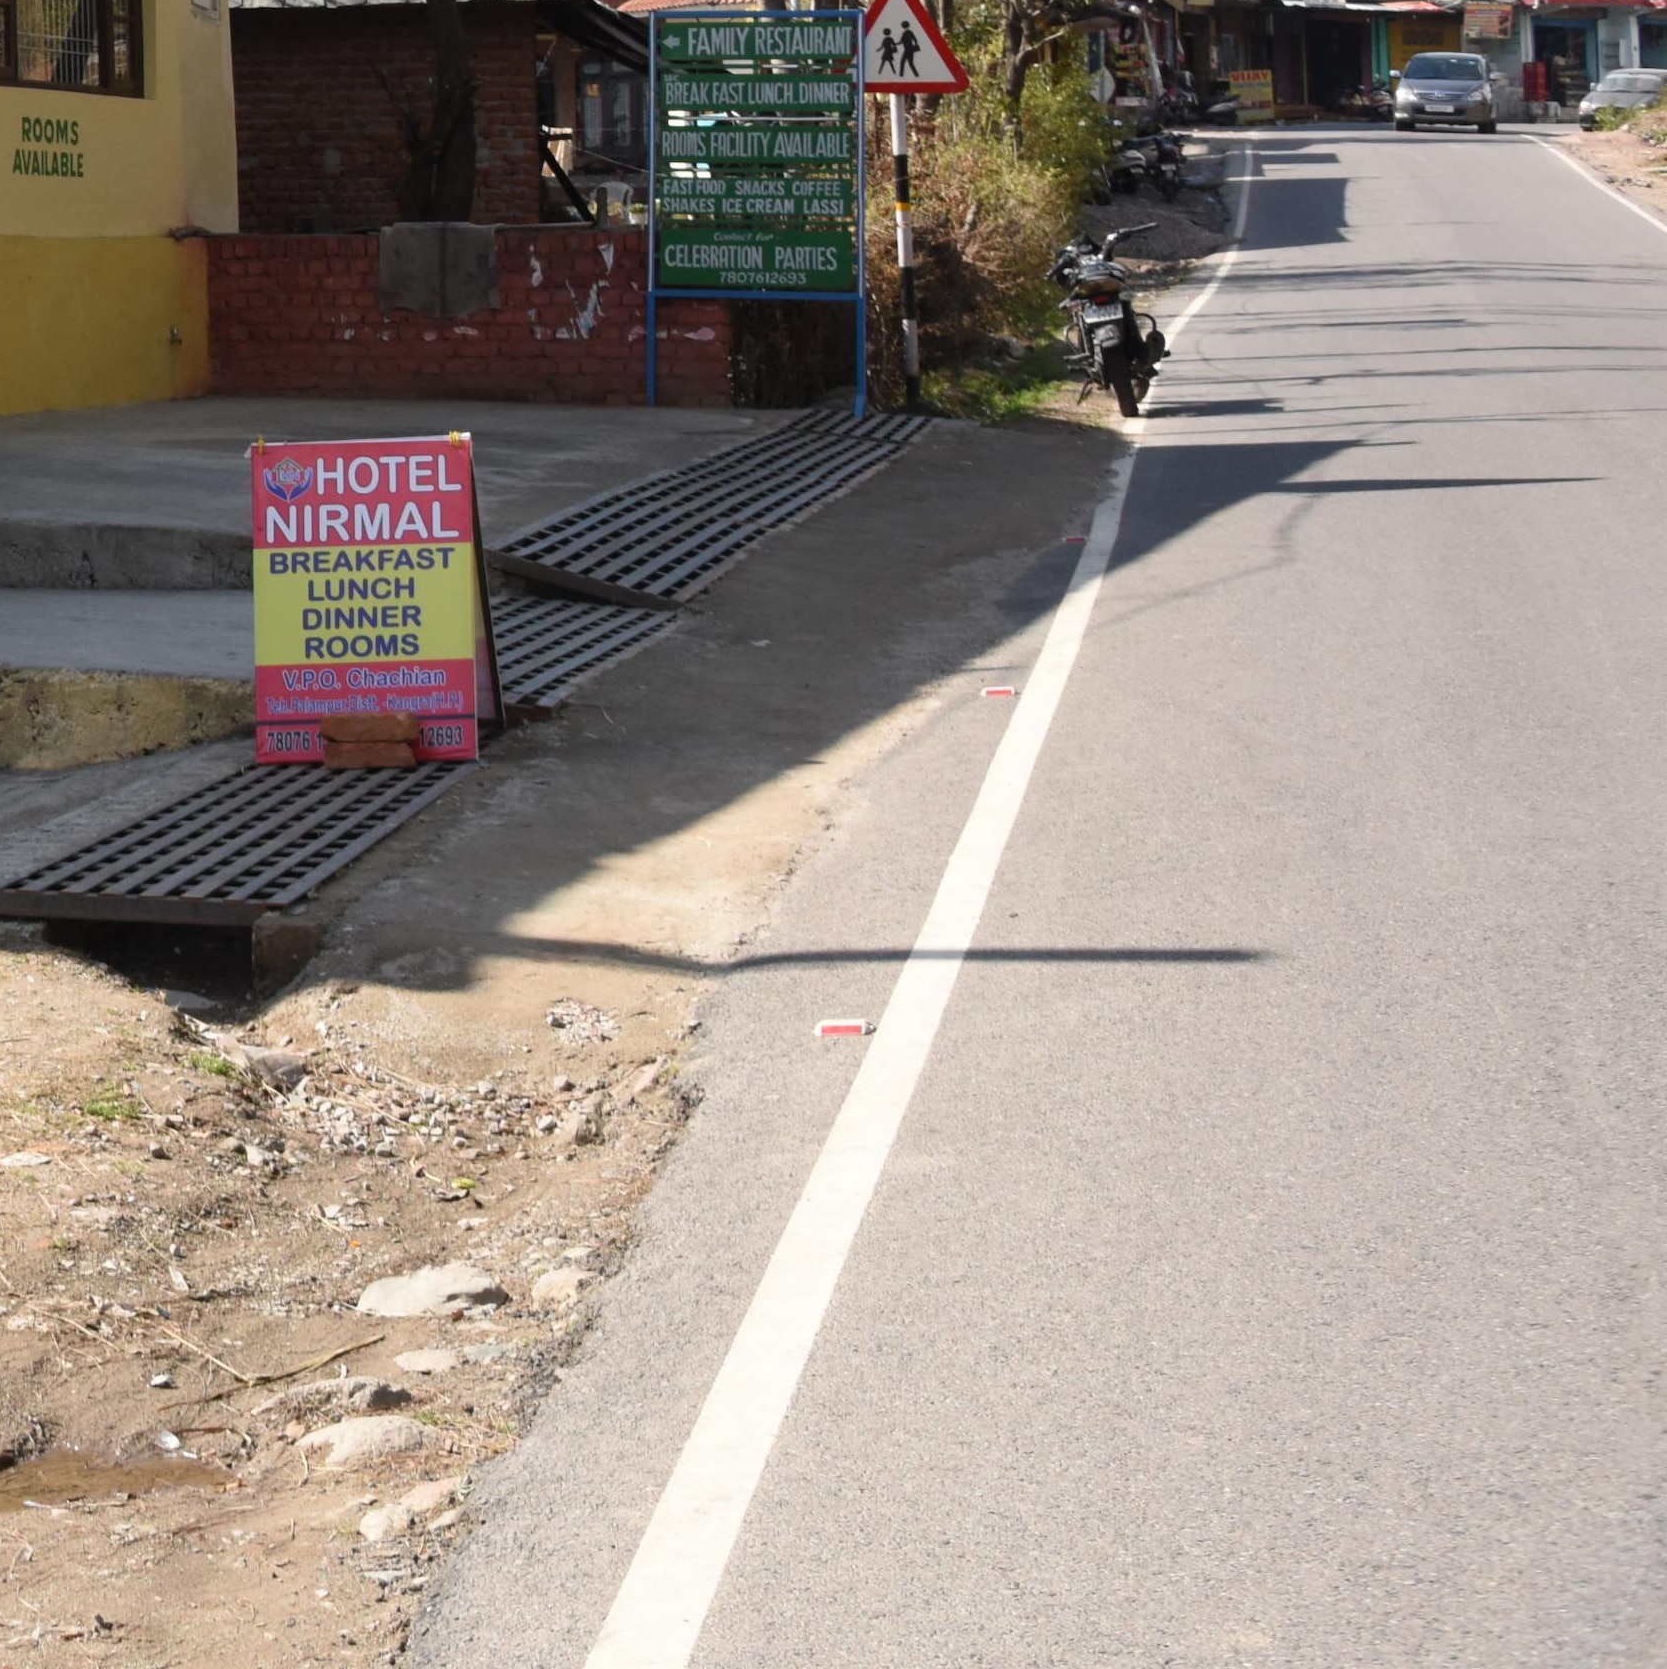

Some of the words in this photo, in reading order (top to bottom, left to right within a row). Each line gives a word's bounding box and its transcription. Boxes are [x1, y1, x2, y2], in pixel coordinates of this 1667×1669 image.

[688, 27, 748, 55] FAMILY
[755, 26, 853, 55] RESTAURANT
[666, 82, 709, 105] BREAK
[799, 82, 849, 105] DINNER
[22, 116, 79, 145] ROOMS
[662, 133, 706, 157] ROOMS
[710, 132, 769, 158] FACILITY
[773, 133, 849, 158] AVAILABLE
[12, 148, 83, 177] AVAILABLE
[735, 180, 785, 196] SNACKS
[792, 181, 840, 196] COFFEE
[662, 199, 714, 213] SHAKES
[722, 199, 743, 213] ICE
[746, 199, 794, 214] CREAM
[803, 199, 844, 214] LASSI
[665, 245, 763, 269] CELEBRATION
[775, 246, 837, 270] PARTIES
[720, 272, 807, 284] 7807612693
[317, 455, 462, 495] HOTEL
[267, 502, 460, 543] NIRMAL
[269, 548, 456, 574] BREAKFAST
[308, 577, 415, 602] LUNCH
[302, 606, 422, 630] DINNER
[305, 634, 420, 659] ROOMS
[282, 669, 341, 690] V.P.O.
[347, 666, 446, 688] Chachian
[267, 731, 310, 752] 78076
[419, 725, 463, 747] 12693
